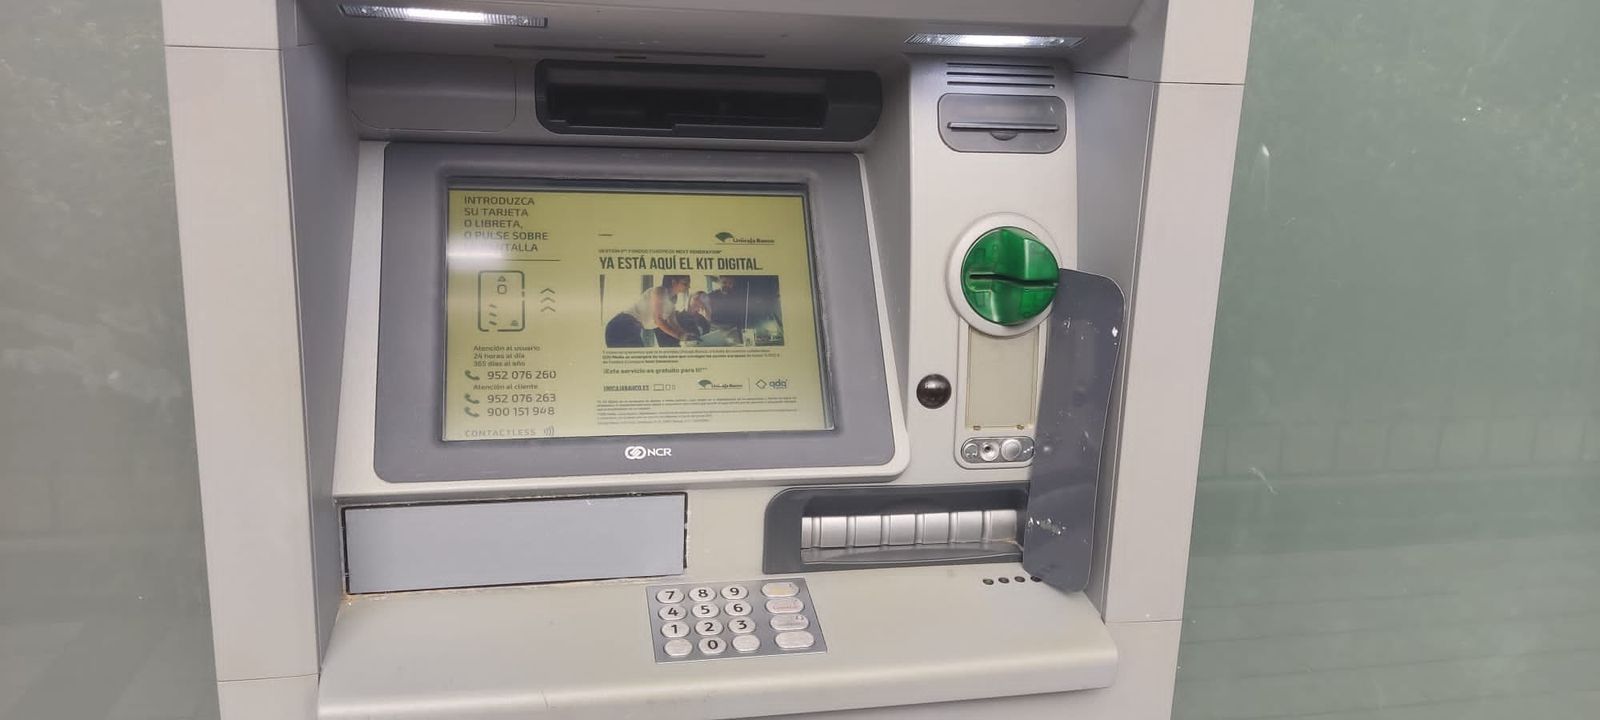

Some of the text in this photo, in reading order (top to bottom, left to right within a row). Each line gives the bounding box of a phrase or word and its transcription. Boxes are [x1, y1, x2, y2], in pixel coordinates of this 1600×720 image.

[464, 196, 535, 206] INTRODUZCA
[464, 208, 529, 217] SU TARJETA
[464, 220, 523, 229] O LIBRETA,
[464, 231, 549, 240] O PULSE SOBRE
[599, 255, 763, 270] YA ESTÁ AQUÍ EL KIT DIGITAL.
[487, 370, 557, 380] 952 076 260
[487, 393, 557, 403] 952 076 263
[487, 406, 555, 416] 900 151 948
[464, 428, 536, 437] CONTACTLESS
[647, 447, 672, 457] NCR
[665, 587, 740, 600] 7 8 9
[667, 603, 743, 616] 4 5 6
[671, 620, 747, 634] 1 2 3
[707, 639, 718, 650] 0
